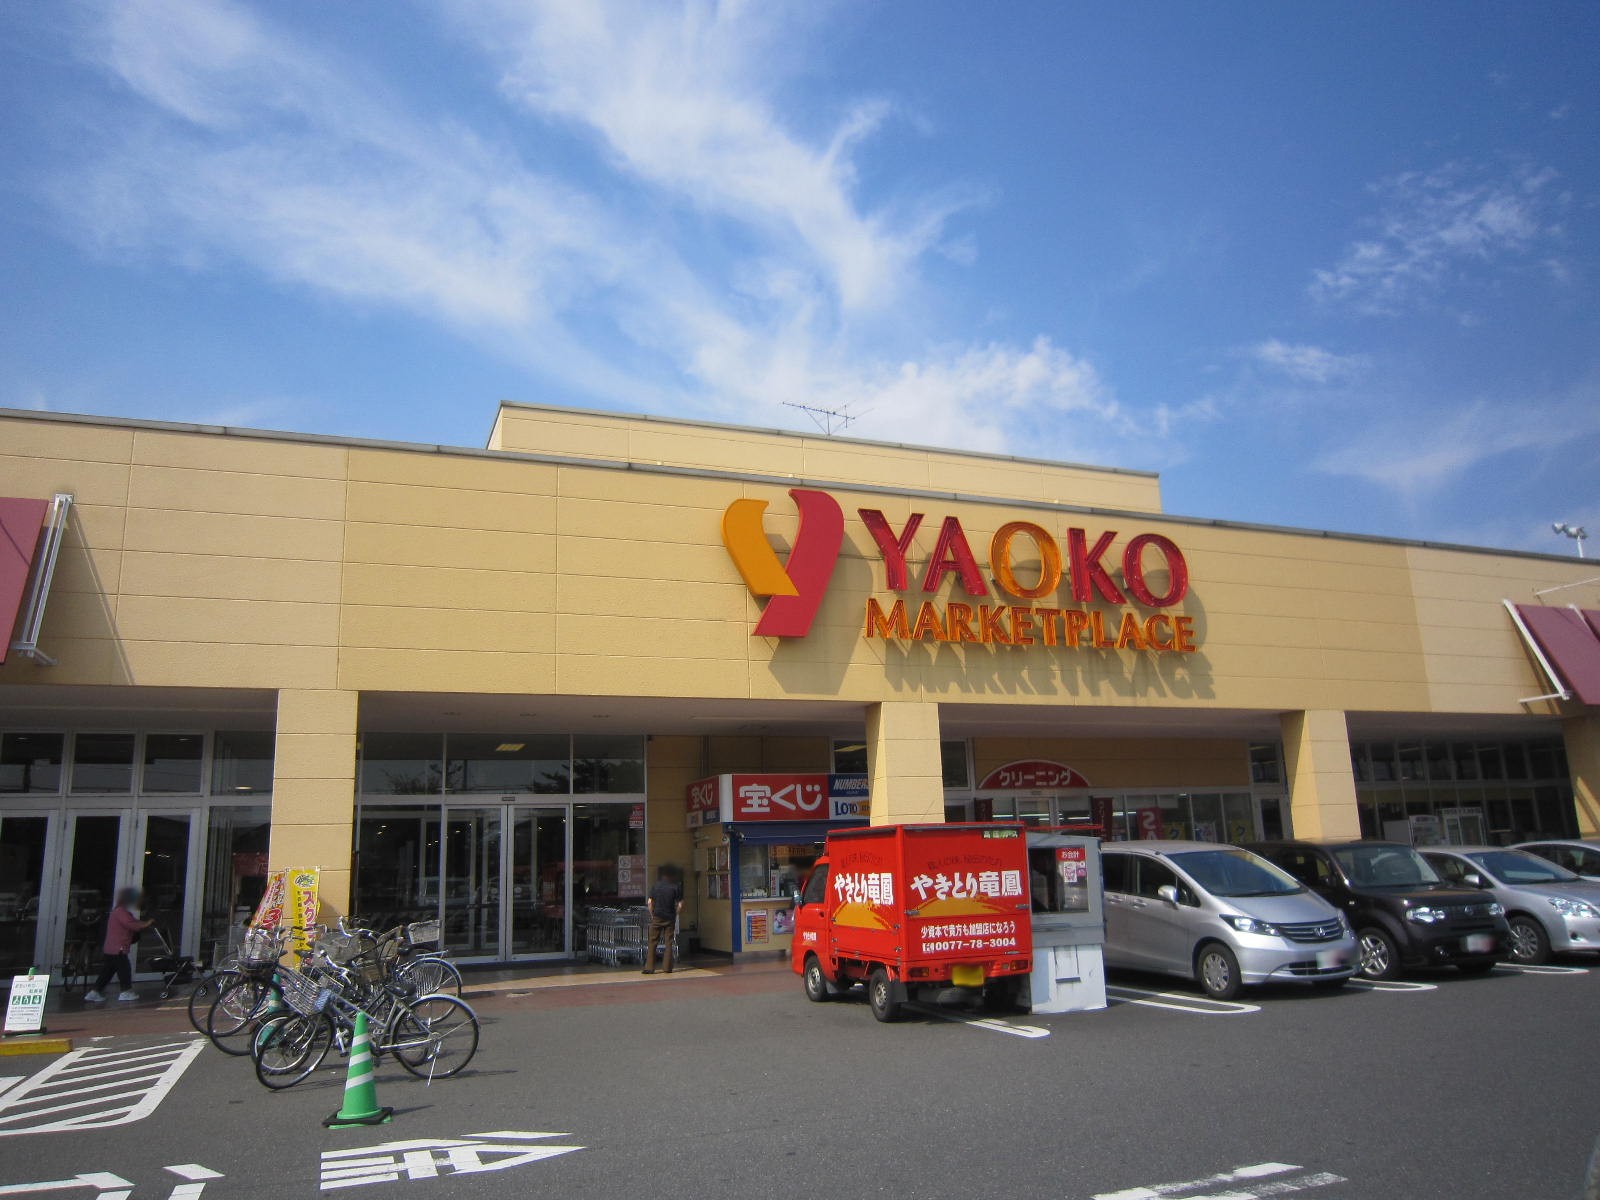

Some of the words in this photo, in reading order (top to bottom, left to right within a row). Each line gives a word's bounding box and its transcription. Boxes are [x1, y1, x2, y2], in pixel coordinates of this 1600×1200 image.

[857, 508, 1188, 607] YAOKO
[864, 598, 1197, 653] MARKETPLACE
[833, 778, 869, 790] NUMBER
[1000, 768, 1071, 786] クリーニング
[739, 783, 822, 812] 宝くじ
[834, 873, 894, 905] やきとり竜鳳
[910, 870, 1022, 900] やきとり竜鳳
